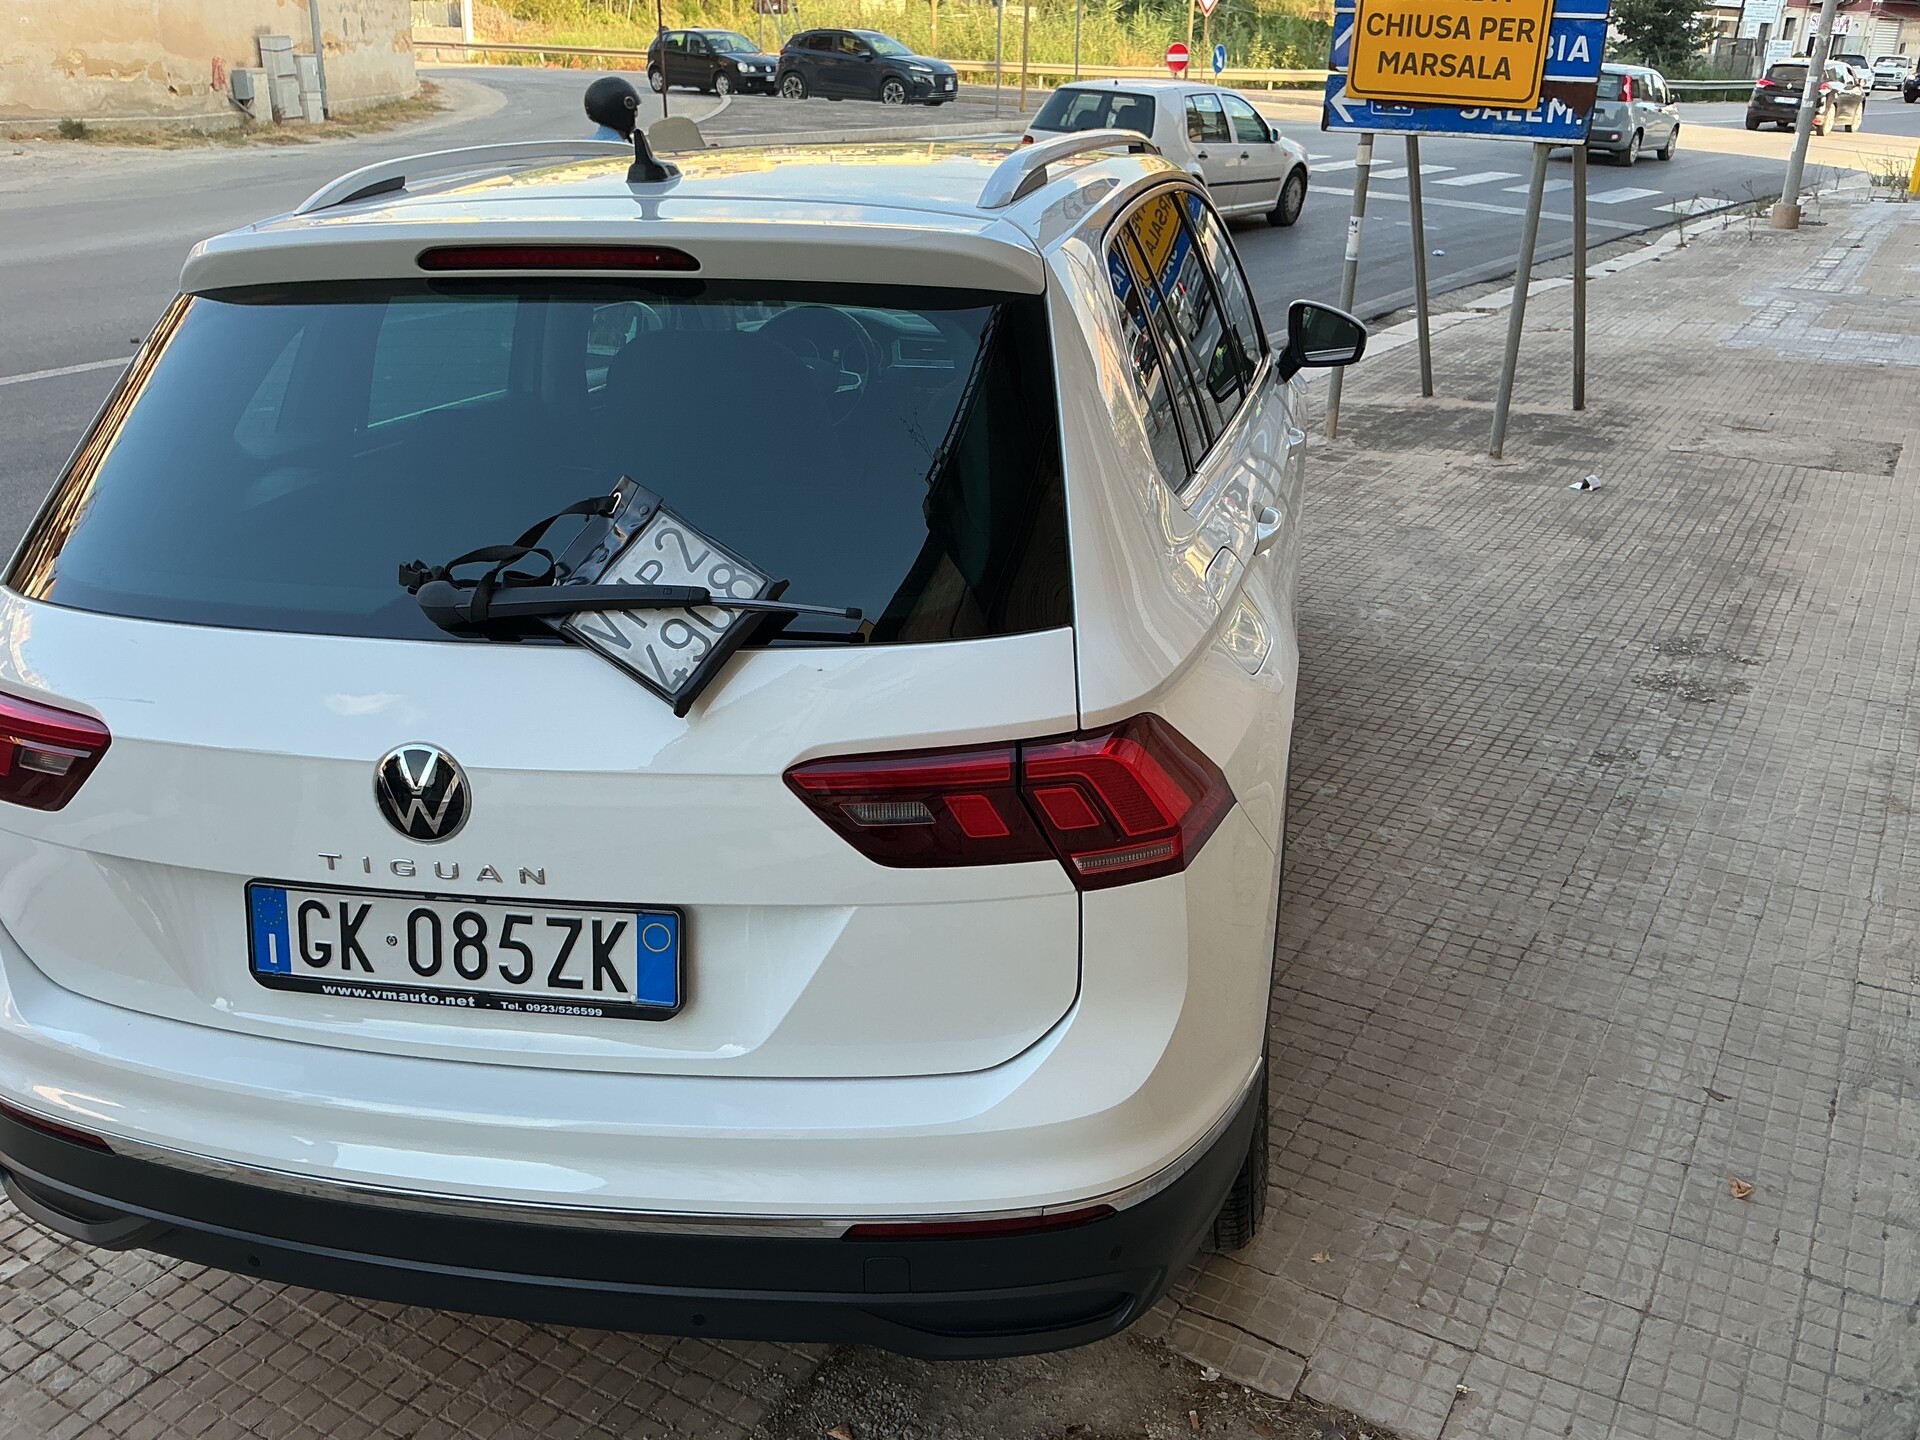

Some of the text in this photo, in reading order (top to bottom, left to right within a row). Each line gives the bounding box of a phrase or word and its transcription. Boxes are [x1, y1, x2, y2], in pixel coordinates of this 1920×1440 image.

[1366, 12, 1536, 43] CHIUSA PER
[1377, 51, 1511, 81] MARSALA
[318, 852, 546, 885] TIGUAN
[298, 899, 375, 973] GK
[407, 907, 629, 993] 085ZK
[322, 984, 475, 1007] www.vmauto.net
[500, 1001, 523, 1011] Tel.
[525, 1004, 603, 1016] 0923/526599
